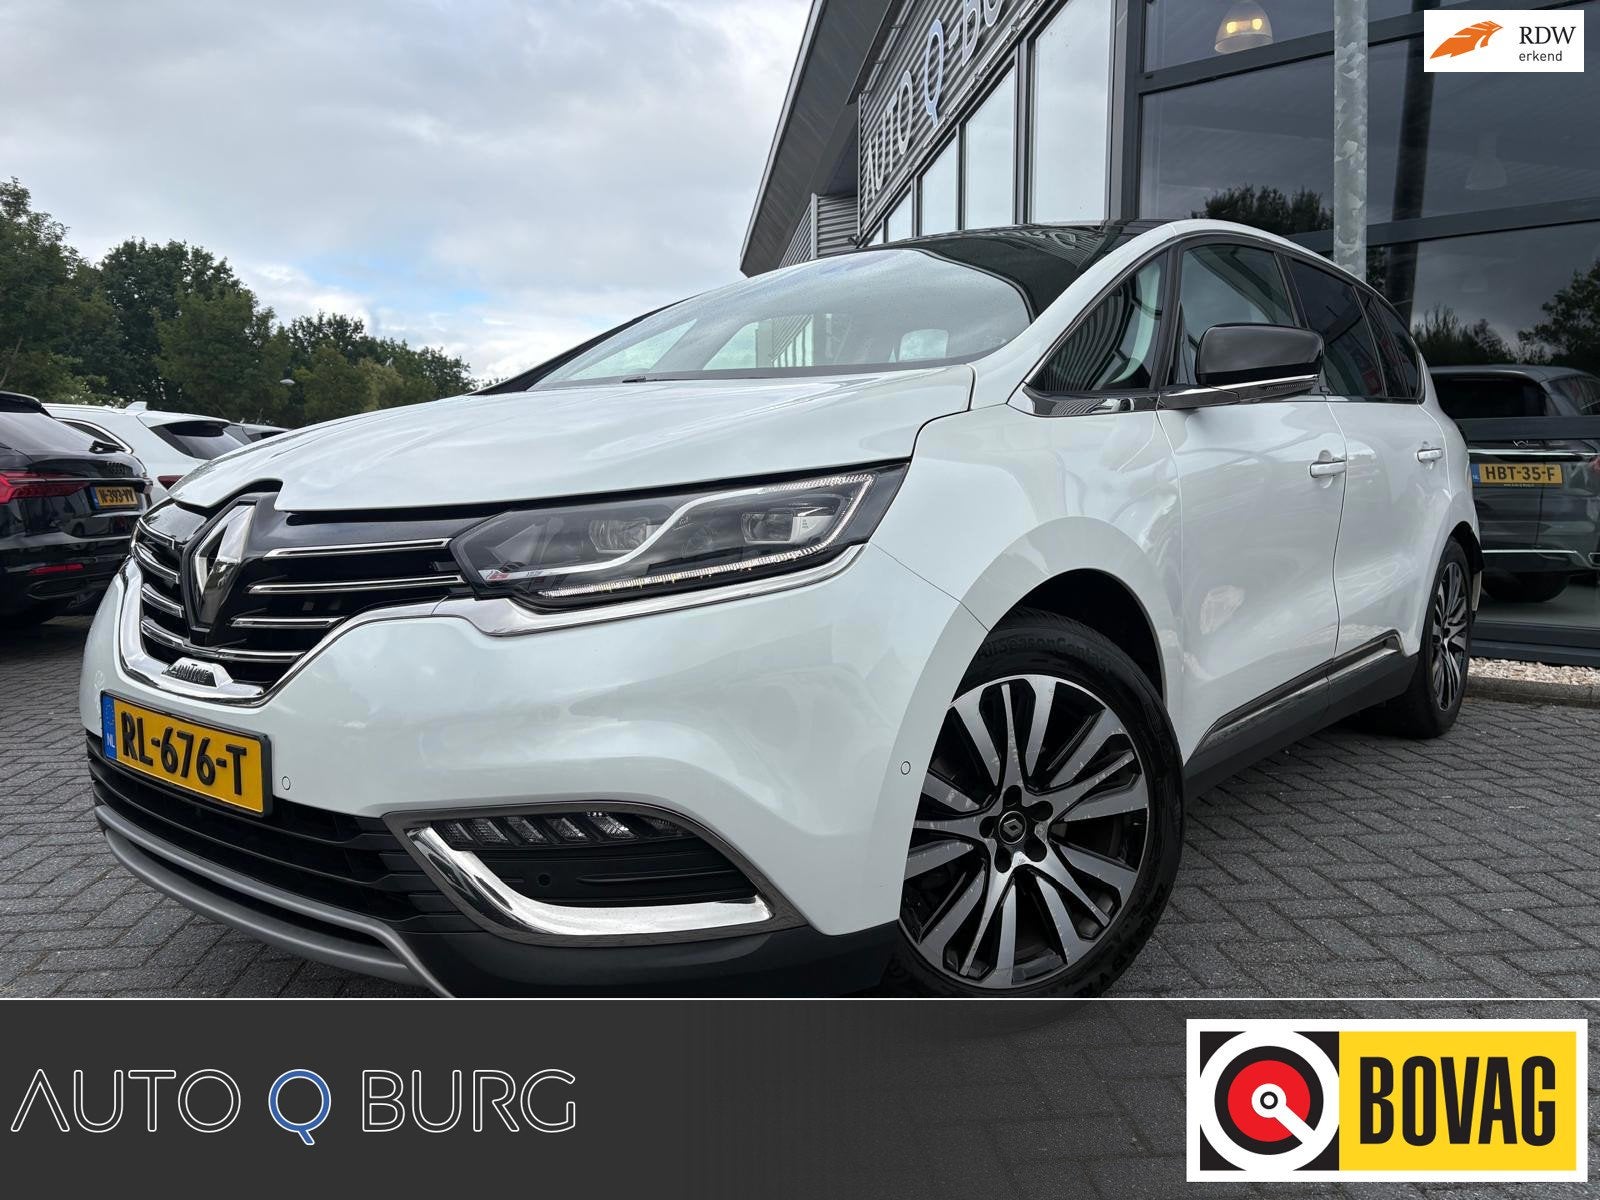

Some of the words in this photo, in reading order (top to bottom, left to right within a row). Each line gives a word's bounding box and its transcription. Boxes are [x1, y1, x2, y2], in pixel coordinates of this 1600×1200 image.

[863, 70, 913, 214] AUTO
[1485, 466, 1555, 481] HBT-35-F
[120, 711, 248, 796] RL-676-T
